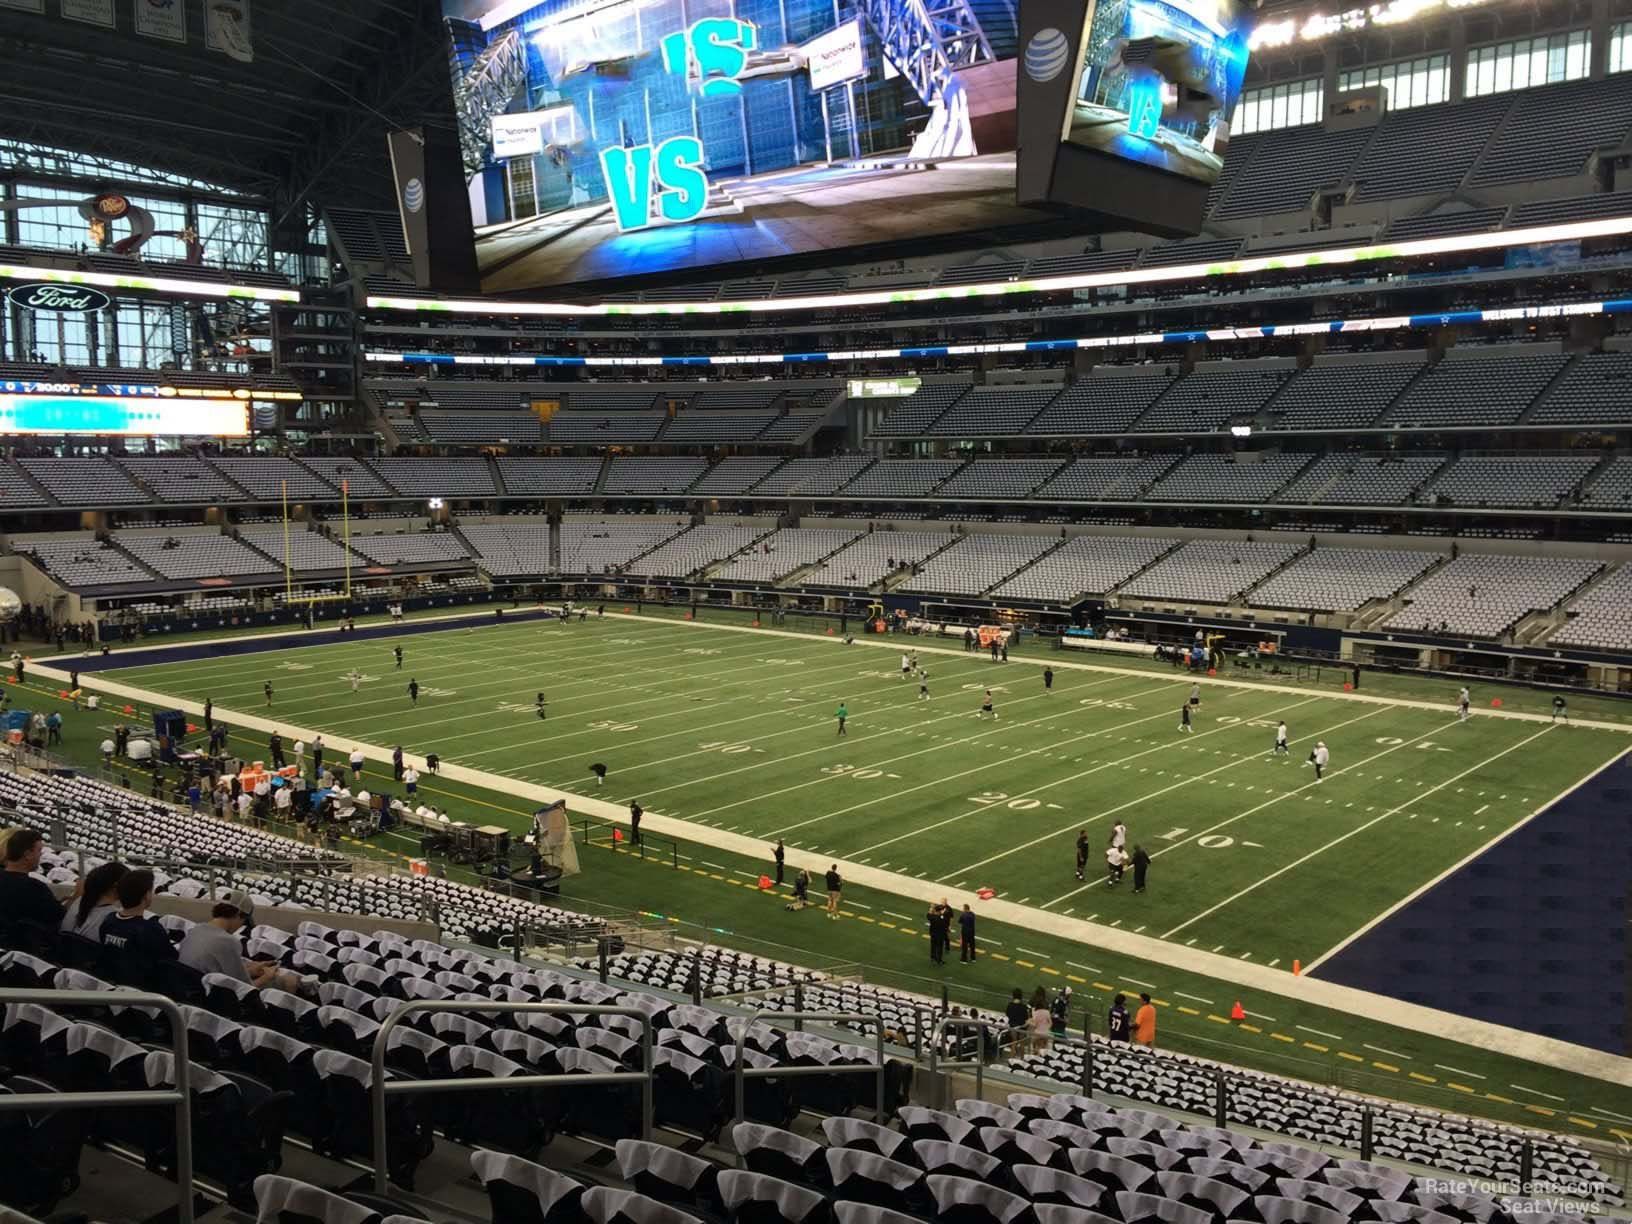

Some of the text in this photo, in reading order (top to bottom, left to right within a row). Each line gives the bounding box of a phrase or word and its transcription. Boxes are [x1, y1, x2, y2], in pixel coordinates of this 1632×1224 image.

[599, 136, 711, 232] VS
[28, 286, 91, 309] Ford
[967, 792, 1041, 809] 20
[1154, 827, 1234, 848] 10
